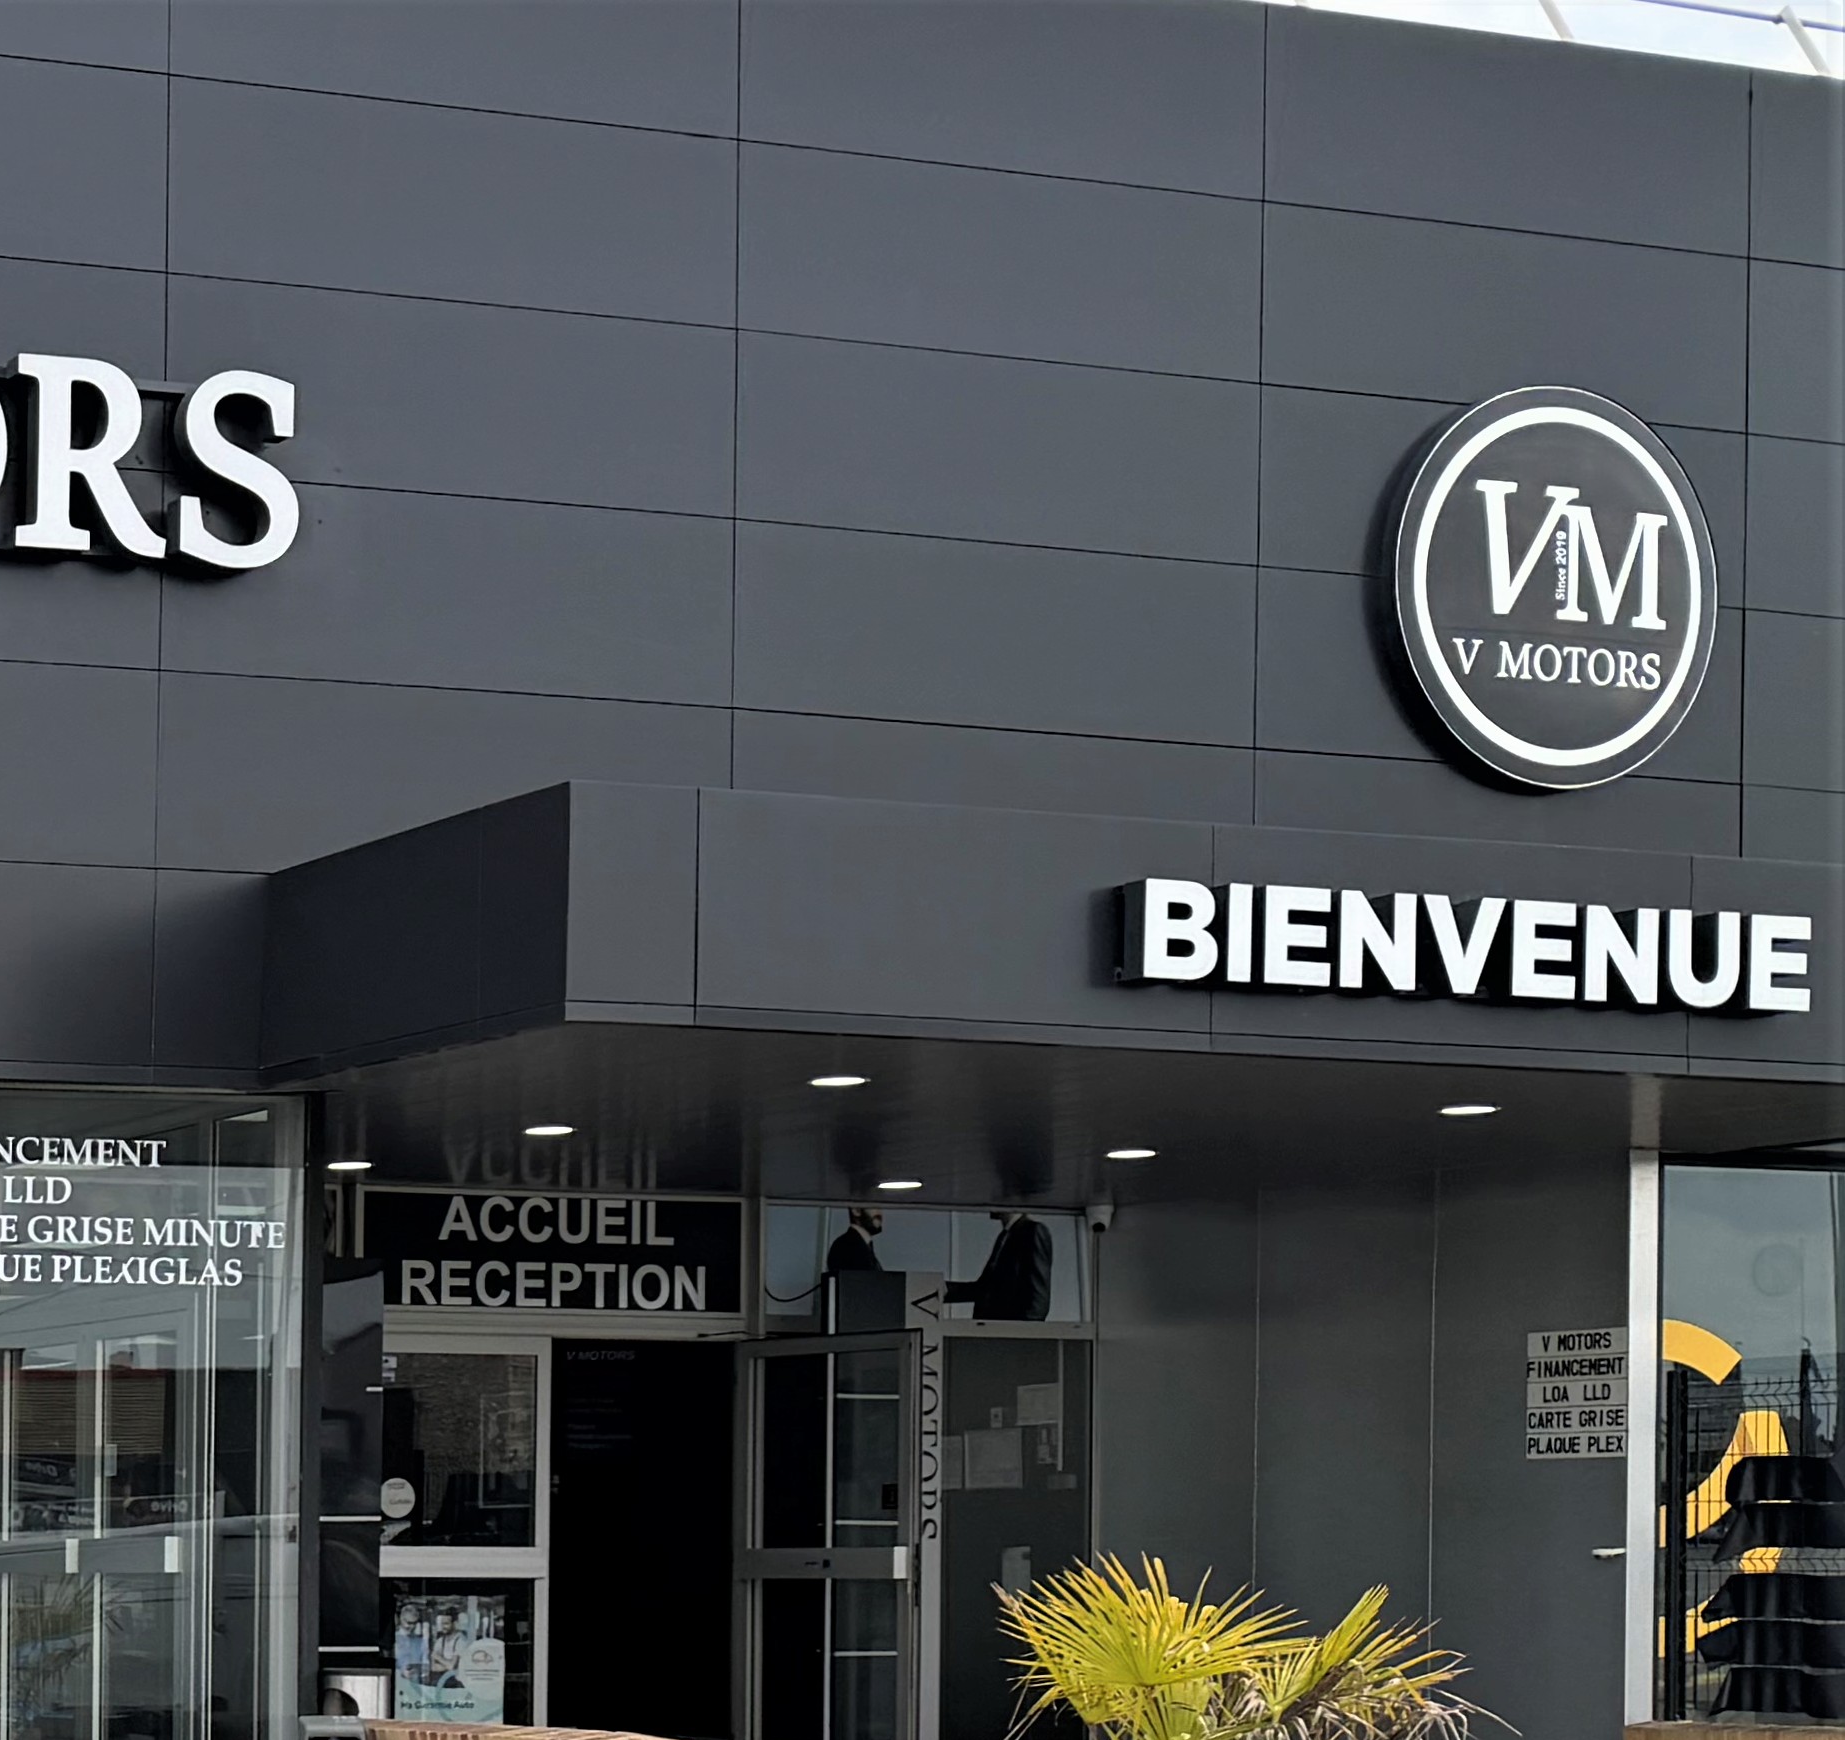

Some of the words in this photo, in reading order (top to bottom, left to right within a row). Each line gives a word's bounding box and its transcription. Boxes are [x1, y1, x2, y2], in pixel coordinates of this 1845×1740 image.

[1452, 637, 1485, 676] V
[1494, 640, 1662, 691] MOTORS
[1142, 877, 1812, 1012] BIENVENUE
[27, 1215, 135, 1246] GRISE
[142, 1217, 287, 1250] MINUTE
[437, 1195, 675, 1246] ACCUEIL
[50, 1255, 244, 1287] PLEXIGLAS
[401, 1259, 706, 1311] RECEPTION
[911, 1291, 940, 1321] V
[1542, 1335, 1550, 1353] V
[1557, 1332, 1612, 1352] MOTORS
[1526, 1357, 1625, 1379] FINANCEMENT
[1542, 1385, 1569, 1403] LOA
[1583, 1383, 1611, 1401] LLD
[1528, 1411, 1572, 1429] CARTE
[1579, 1408, 1624, 1428] GRISE
[1527, 1436, 1580, 1454] PLAQUE
[1587, 1435, 1624, 1453] PLEX
